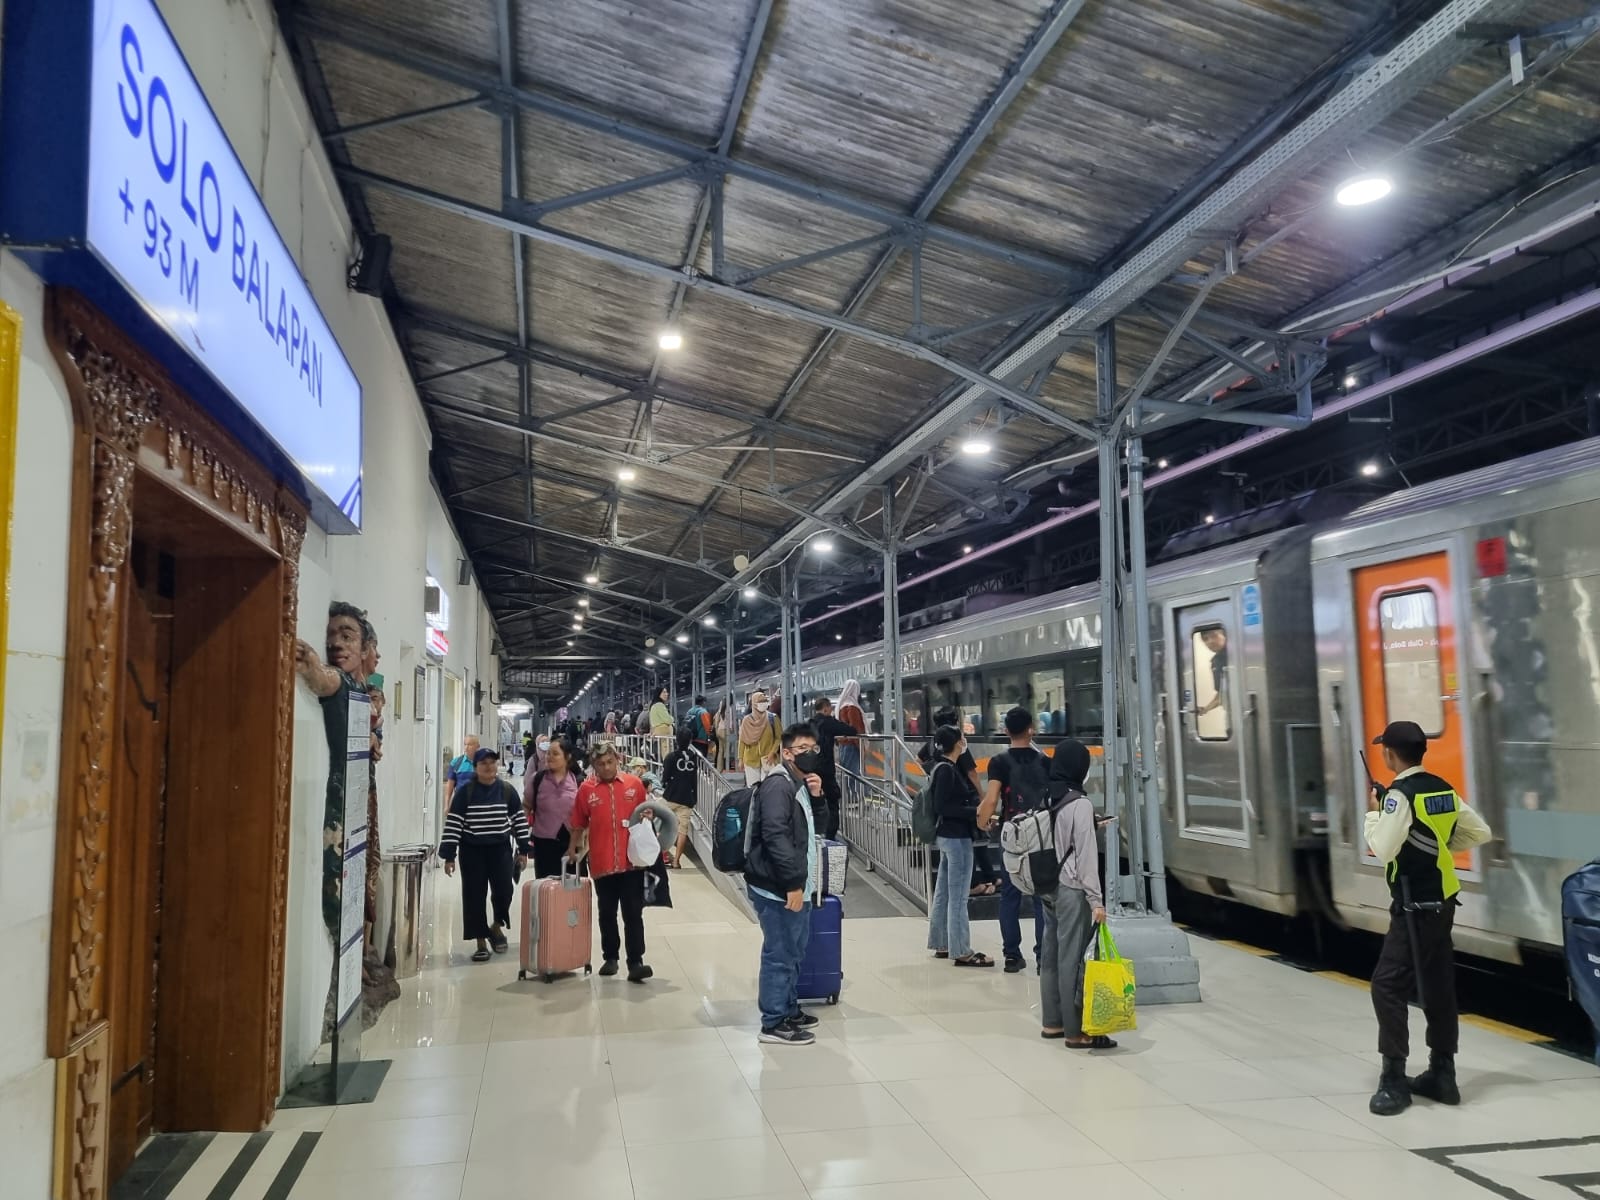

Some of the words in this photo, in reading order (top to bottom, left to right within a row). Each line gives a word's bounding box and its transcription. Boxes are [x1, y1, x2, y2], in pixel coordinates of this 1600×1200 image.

[118, 23, 222, 253] SOLO
[232, 205, 323, 408] BALAPAN
[180, 239, 198, 313] M
